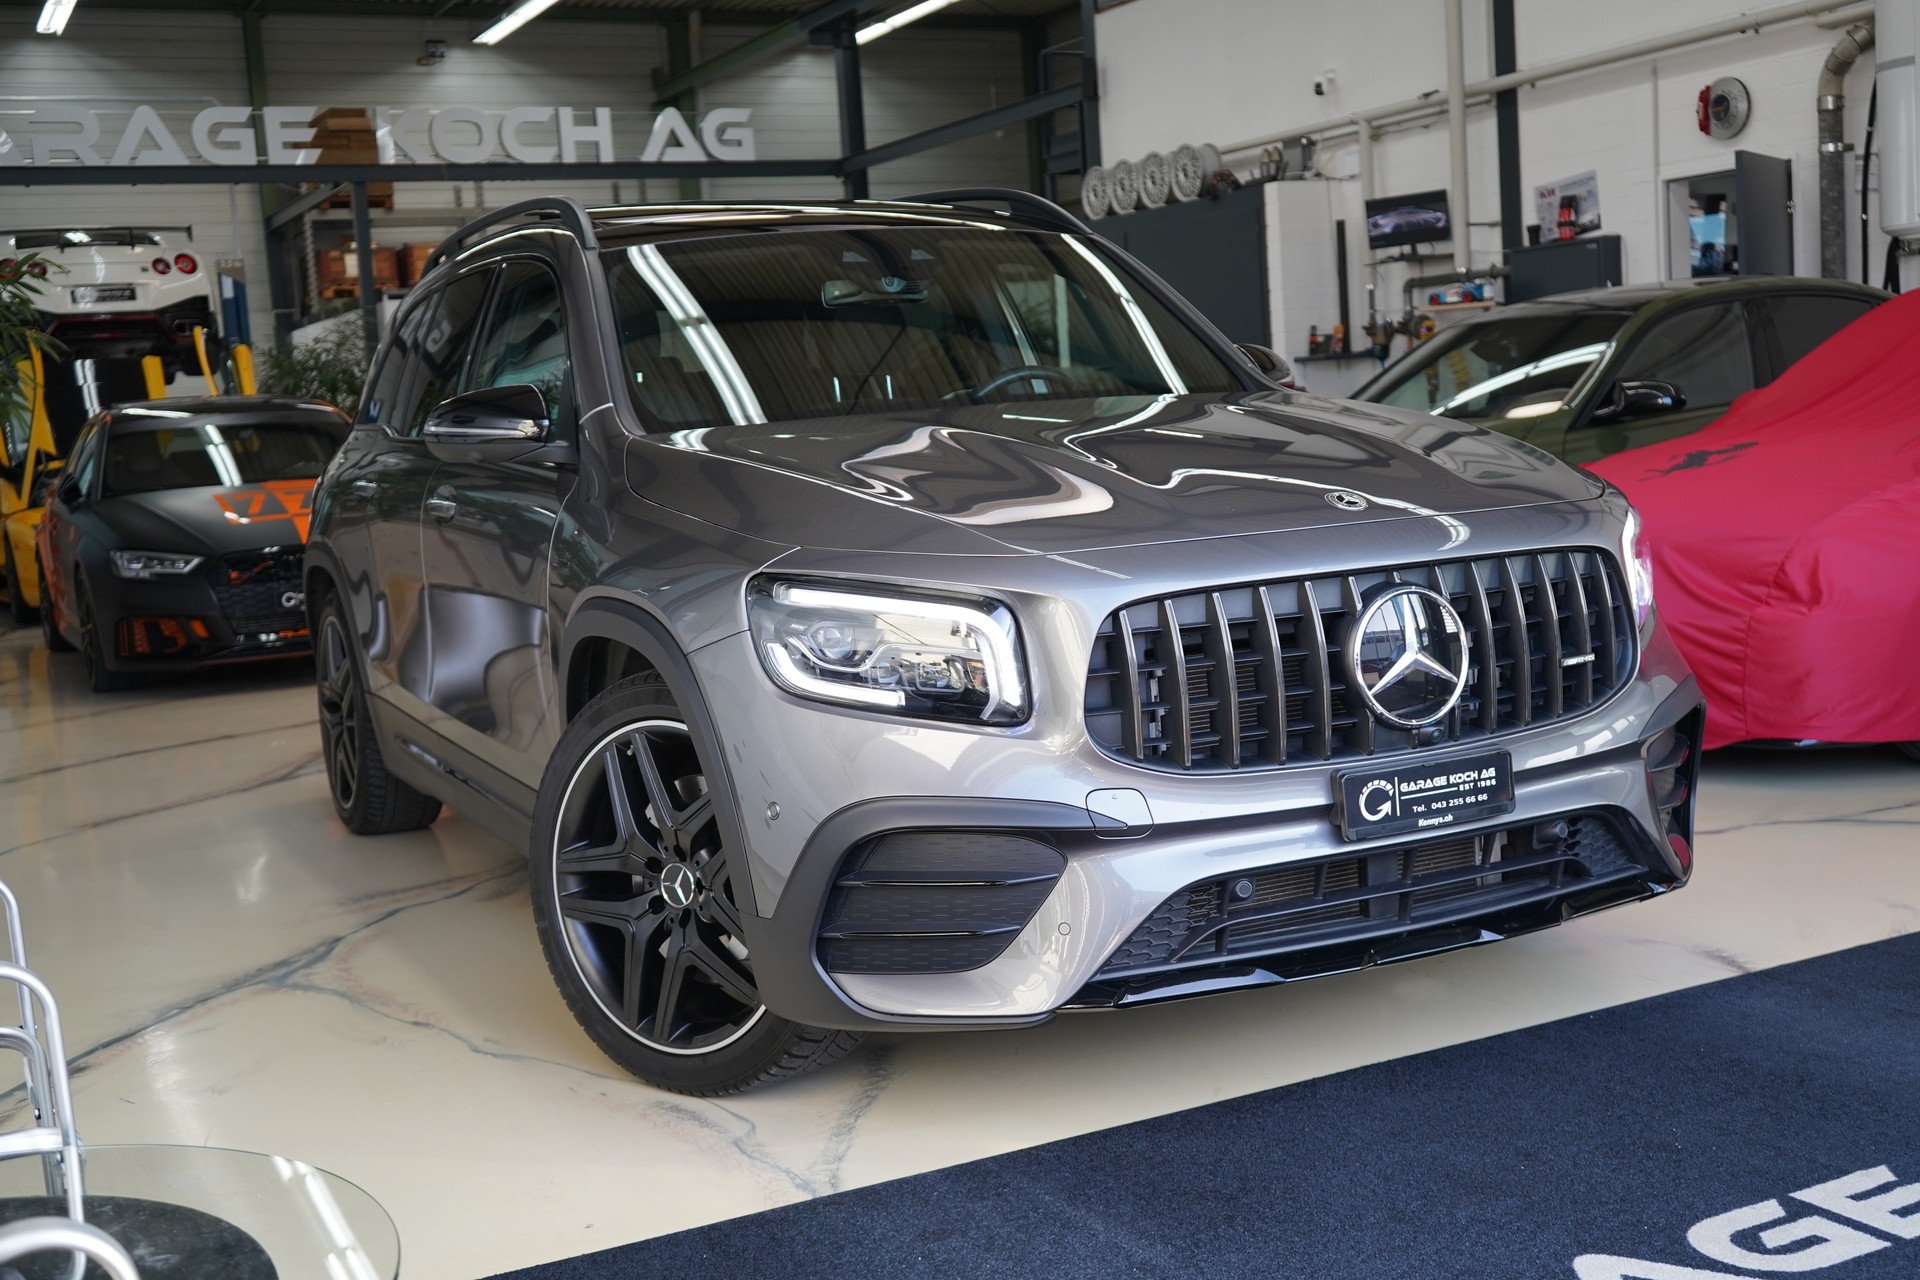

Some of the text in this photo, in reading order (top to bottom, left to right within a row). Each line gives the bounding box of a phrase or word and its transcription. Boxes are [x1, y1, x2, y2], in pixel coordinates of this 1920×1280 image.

[0, 104, 756, 166] RAGE KOCH AG
[1400, 767, 1496, 793] GARAGE KOCH AG
[1459, 782, 1475, 791] EST
[1412, 793, 1488, 813] Tel. 043 255 66 66
[1418, 813, 1453, 827] Kennys.ch
